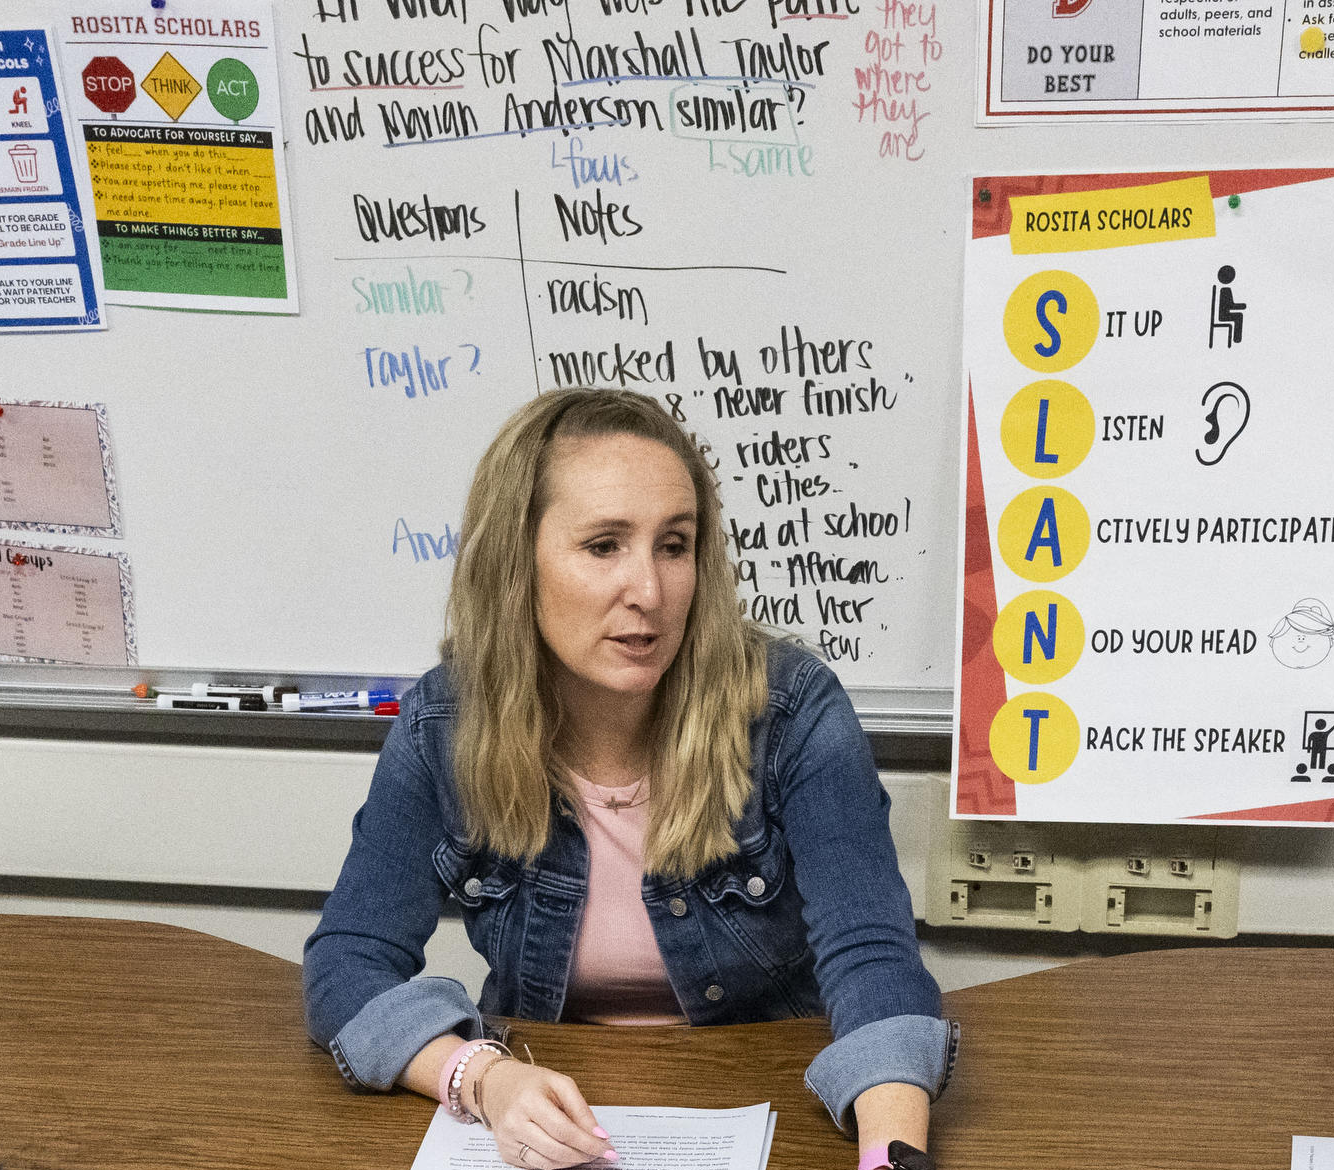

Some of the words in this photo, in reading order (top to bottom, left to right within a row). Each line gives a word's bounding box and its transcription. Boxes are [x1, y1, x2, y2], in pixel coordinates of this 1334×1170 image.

[1160, 8, 1201, 22] adults,
[1205, 8, 1243, 23] peers,
[1247, 5, 1273, 19] and
[71, 17, 148, 34] ROSITA
[155, 18, 260, 37] SCHOLARS
[1159, 25, 1199, 38] school
[1204, 23, 1262, 37] materials
[294, 35, 330, 86] to
[342, 47, 463, 87] success
[468, 24, 520, 86] for
[543, 25, 706, 83] Marshall
[720, 34, 829, 90] Taylor
[1027, 45, 1054, 64] DO
[1061, 44, 1115, 63] YOUR
[86, 76, 131, 91] STOP
[151, 79, 192, 94] THINK
[217, 80, 248, 96] ACT
[1044, 75, 1095, 94] BEST
[306, 97, 364, 145] and
[383, 104, 477, 143] Marian
[504, 92, 662, 136] Anderson
[93, 127, 107, 137] TO
[110, 128, 162, 139] ADVOCATE
[165, 130, 184, 140] FOR
[187, 131, 235, 142] YOURSELF
[8, 215, 26, 223] FOR
[28, 214, 59, 222] GRADE
[353, 193, 486, 242] Questions
[554, 189, 643, 242] Notes
[1026, 210, 1091, 232] ROSITA
[1097, 208, 1193, 231] SCHOLARS
[7, 225, 19, 233] TO
[21, 224, 32, 232] BE
[33, 223, 66, 232] CALLED
[115, 224, 128, 233] TO
[132, 224, 159, 235] MAKE
[162, 225, 198, 237] THINGS
[202, 227, 237, 238] BETTER
[548, 273, 647, 324] racism
[1134, 311, 1163, 337] UP
[549, 342, 674, 387] mocked
[697, 337, 739, 384] by
[761, 327, 873, 379] others
[737, 431, 832, 467] riders
[777, 507, 813, 548] at
[824, 497, 911, 538] school
[1132, 629, 1194, 654] YOUR
[1202, 629, 1257, 655] HEAD
[1152, 728, 1187, 752] THE
[1194, 728, 1285, 753] SPEAKER
